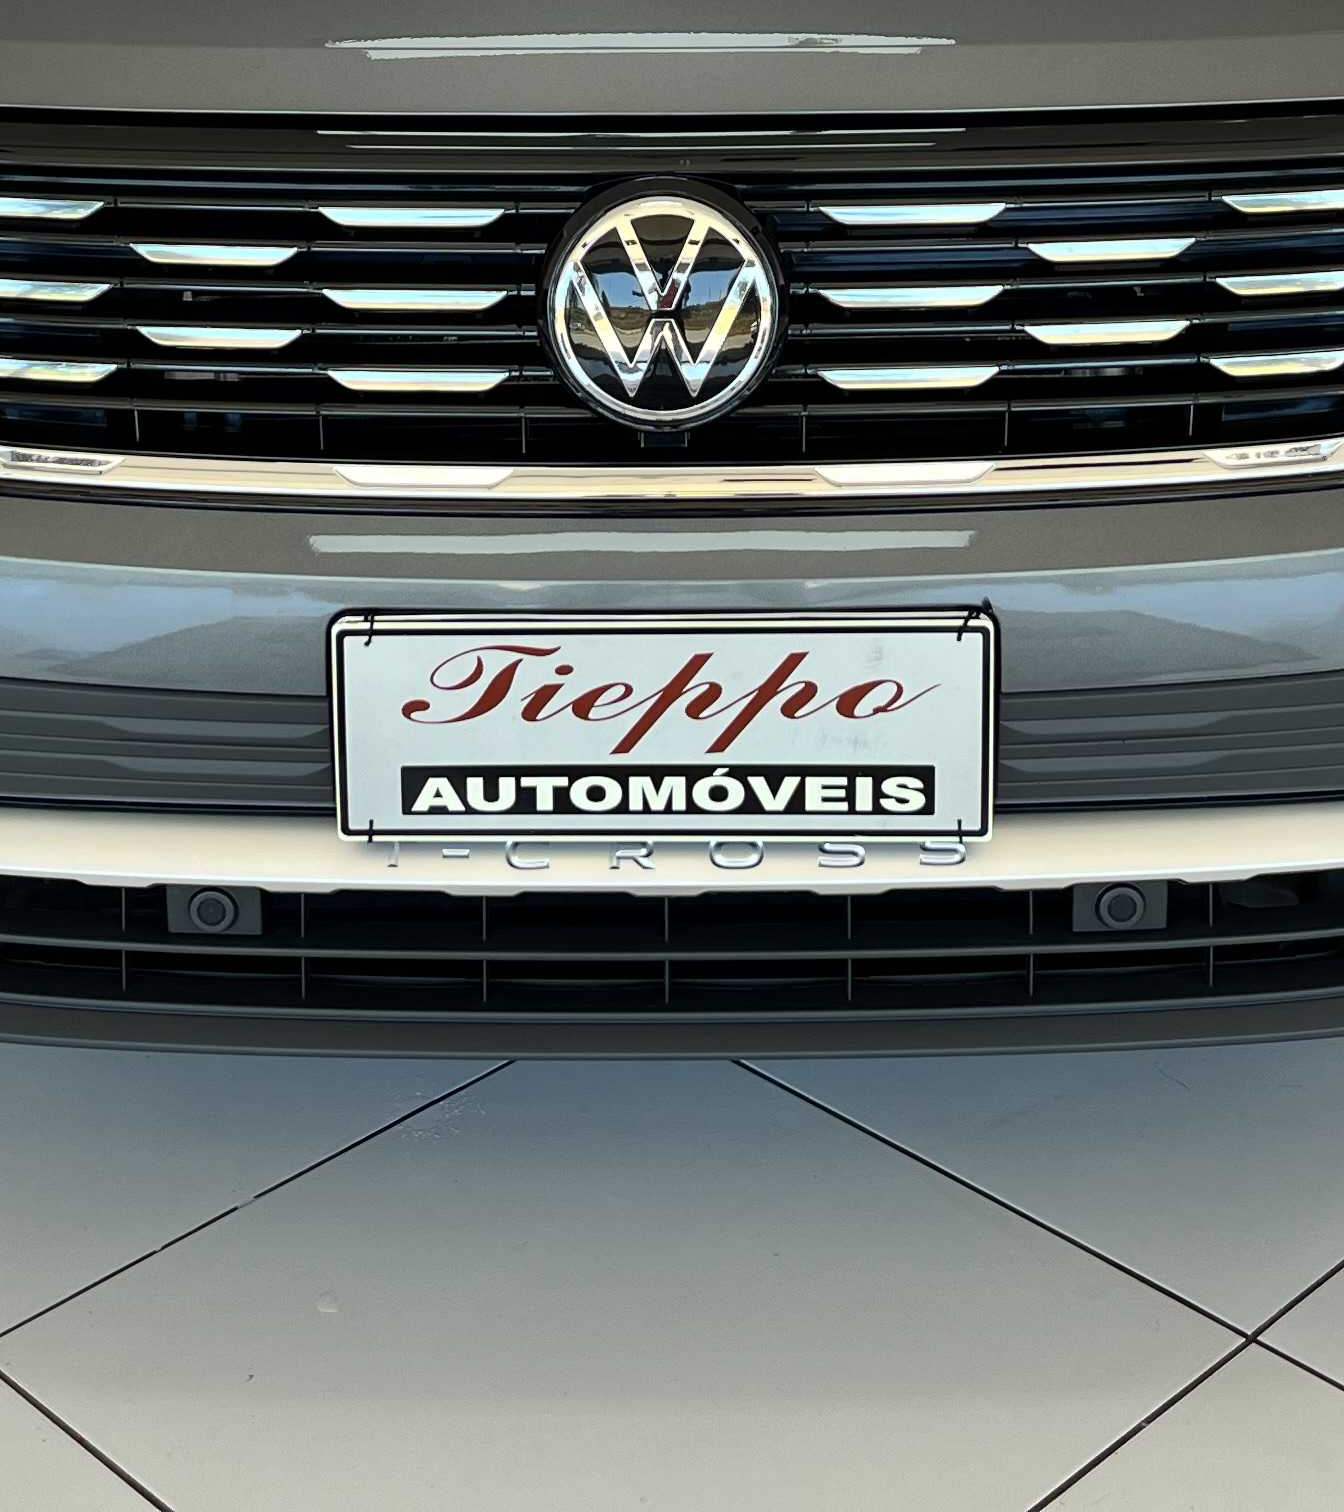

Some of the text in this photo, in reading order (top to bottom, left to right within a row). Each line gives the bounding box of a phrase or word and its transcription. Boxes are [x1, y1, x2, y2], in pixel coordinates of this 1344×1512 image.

[401, 644, 943, 755] Tieppo
[411, 768, 927, 813] AUTOMÓVEIS
[386, 841, 967, 870] -CROSS
